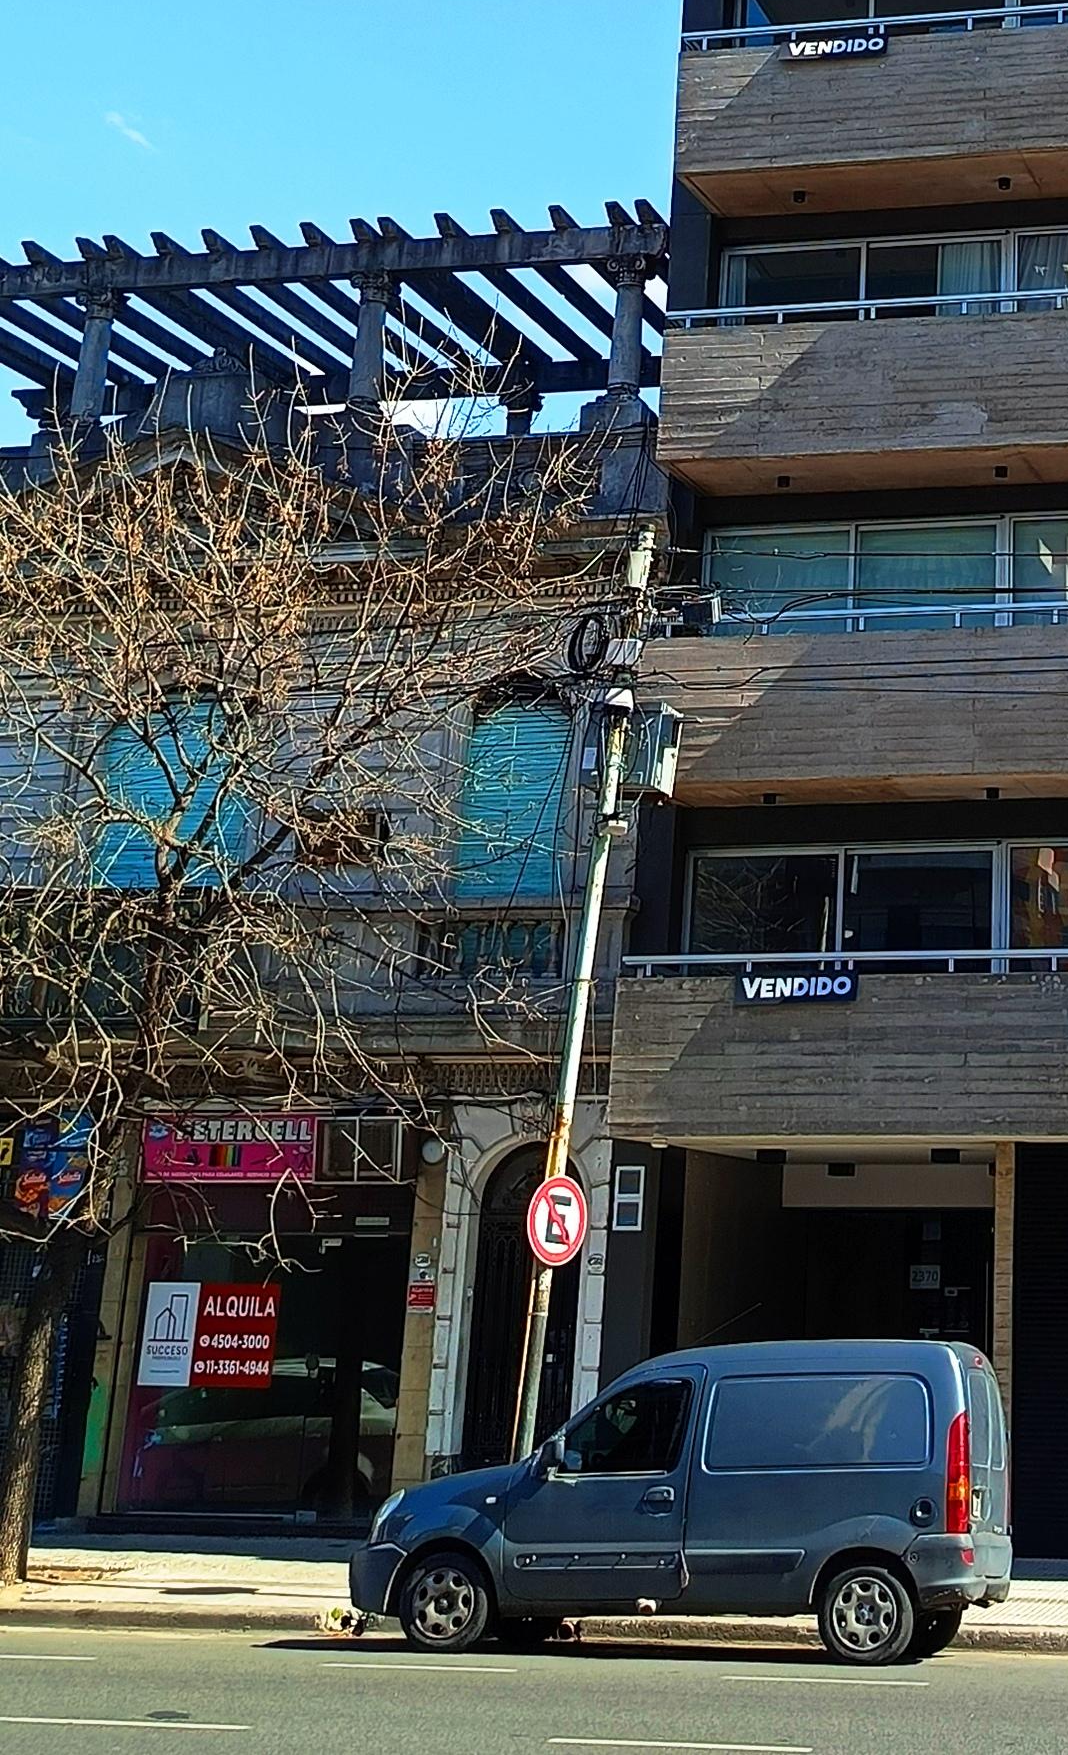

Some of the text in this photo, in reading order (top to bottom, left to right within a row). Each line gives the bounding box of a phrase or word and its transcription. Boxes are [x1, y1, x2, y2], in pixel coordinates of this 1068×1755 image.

[788, 38, 884, 56] VENDIDO
[741, 976, 852, 999] VENDIDO
[911, 1270, 939, 1282] 2370
[203, 1296, 276, 1317] ALQUILA
[211, 1334, 270, 1349] 4504-3000
[146, 1346, 189, 1355] SUCCESO
